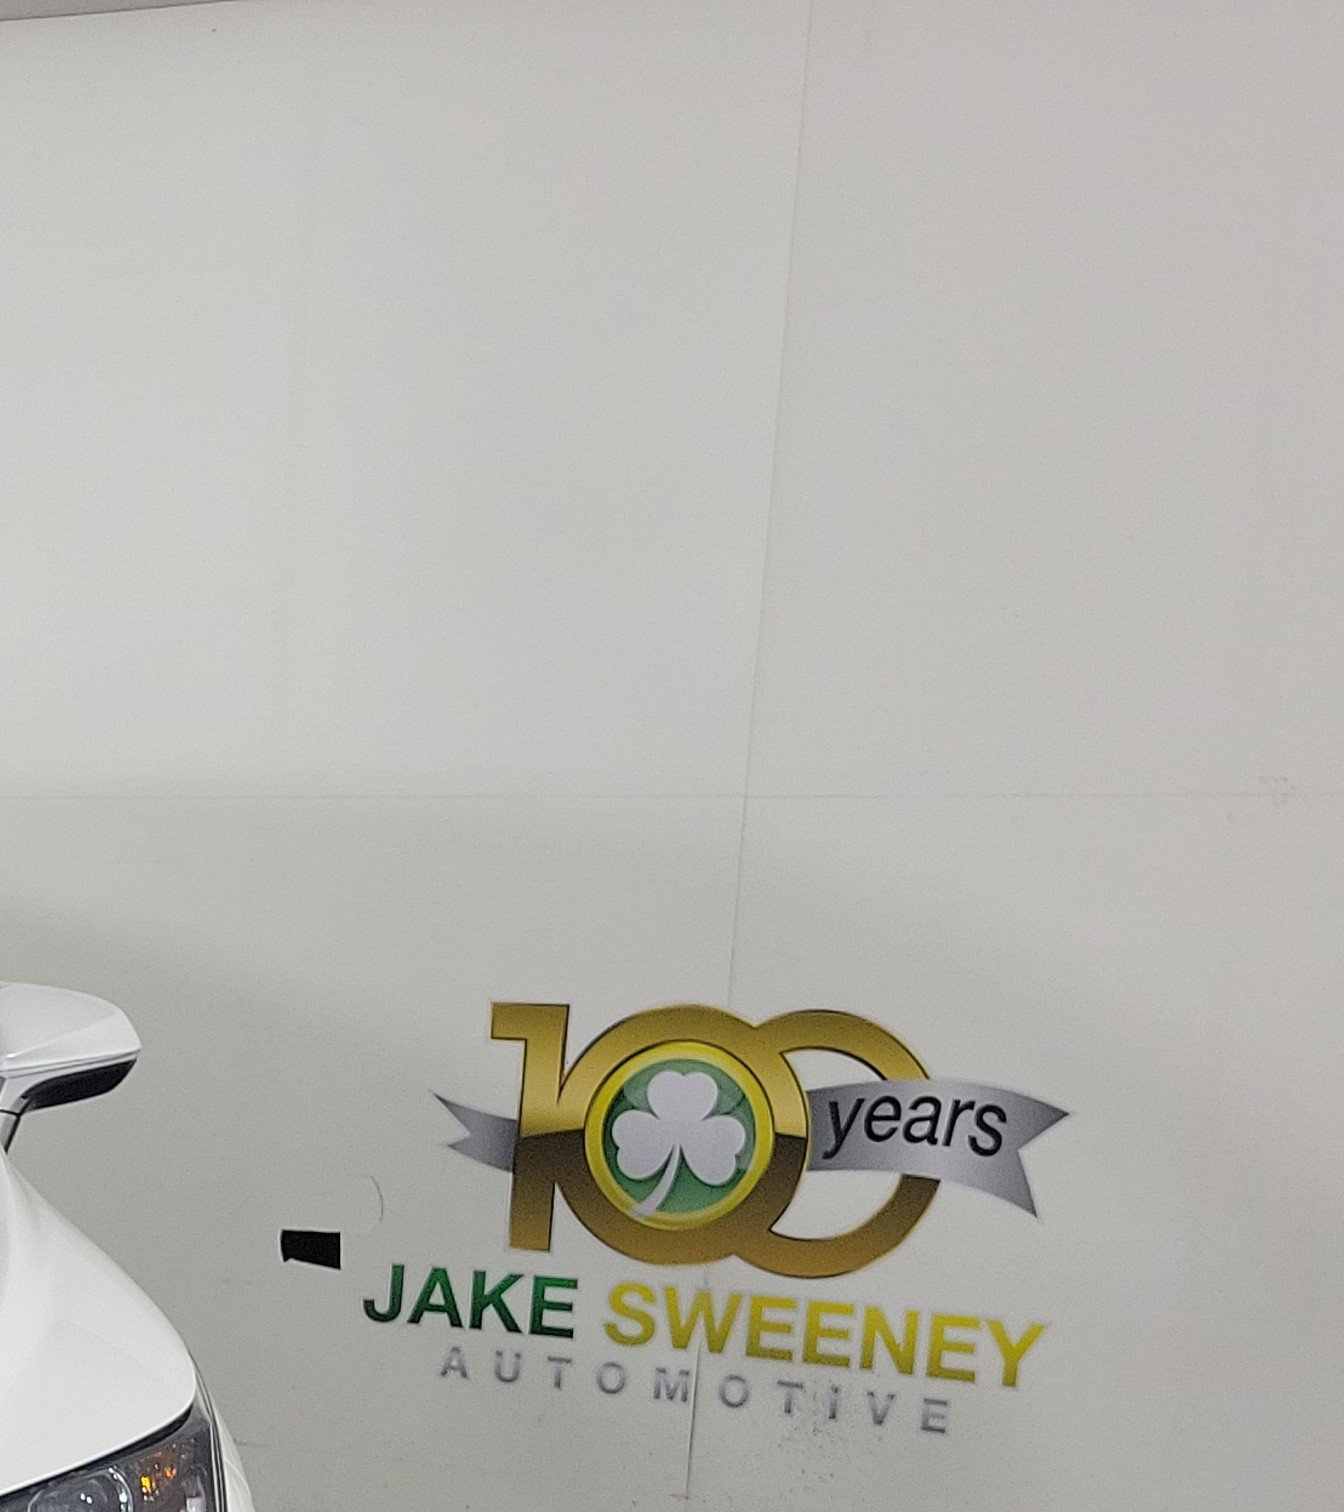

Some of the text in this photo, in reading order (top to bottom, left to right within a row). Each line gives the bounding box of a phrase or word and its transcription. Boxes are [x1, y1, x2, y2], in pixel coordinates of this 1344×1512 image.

[490, 1002, 1007, 1279] 100 years
[362, 1264, 1046, 1388] JAKE SWEENEY
[440, 1346, 950, 1434] AUTOMOTIVE
